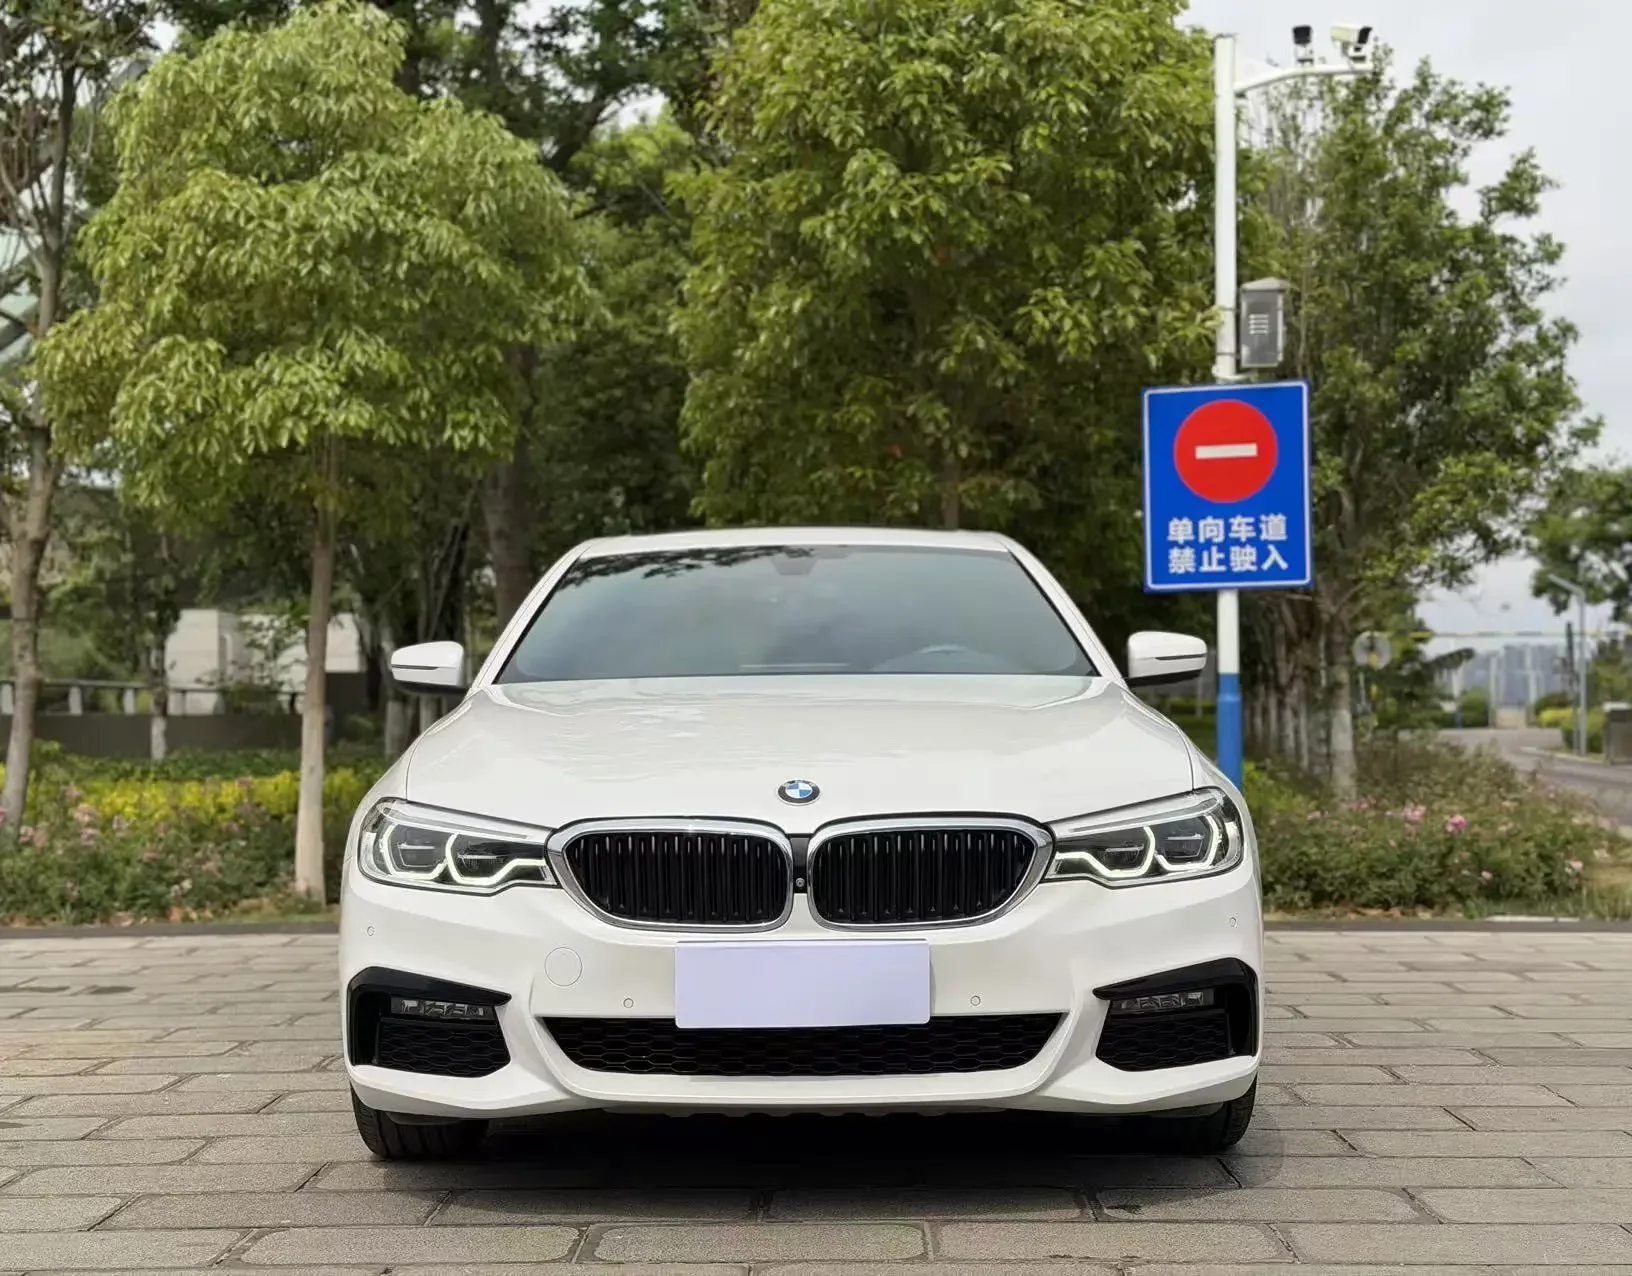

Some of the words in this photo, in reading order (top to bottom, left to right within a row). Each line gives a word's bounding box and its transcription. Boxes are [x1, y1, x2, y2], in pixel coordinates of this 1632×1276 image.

[1167, 513, 1288, 544] 单向车道
[1168, 544, 1289, 574] 禁止驶入
